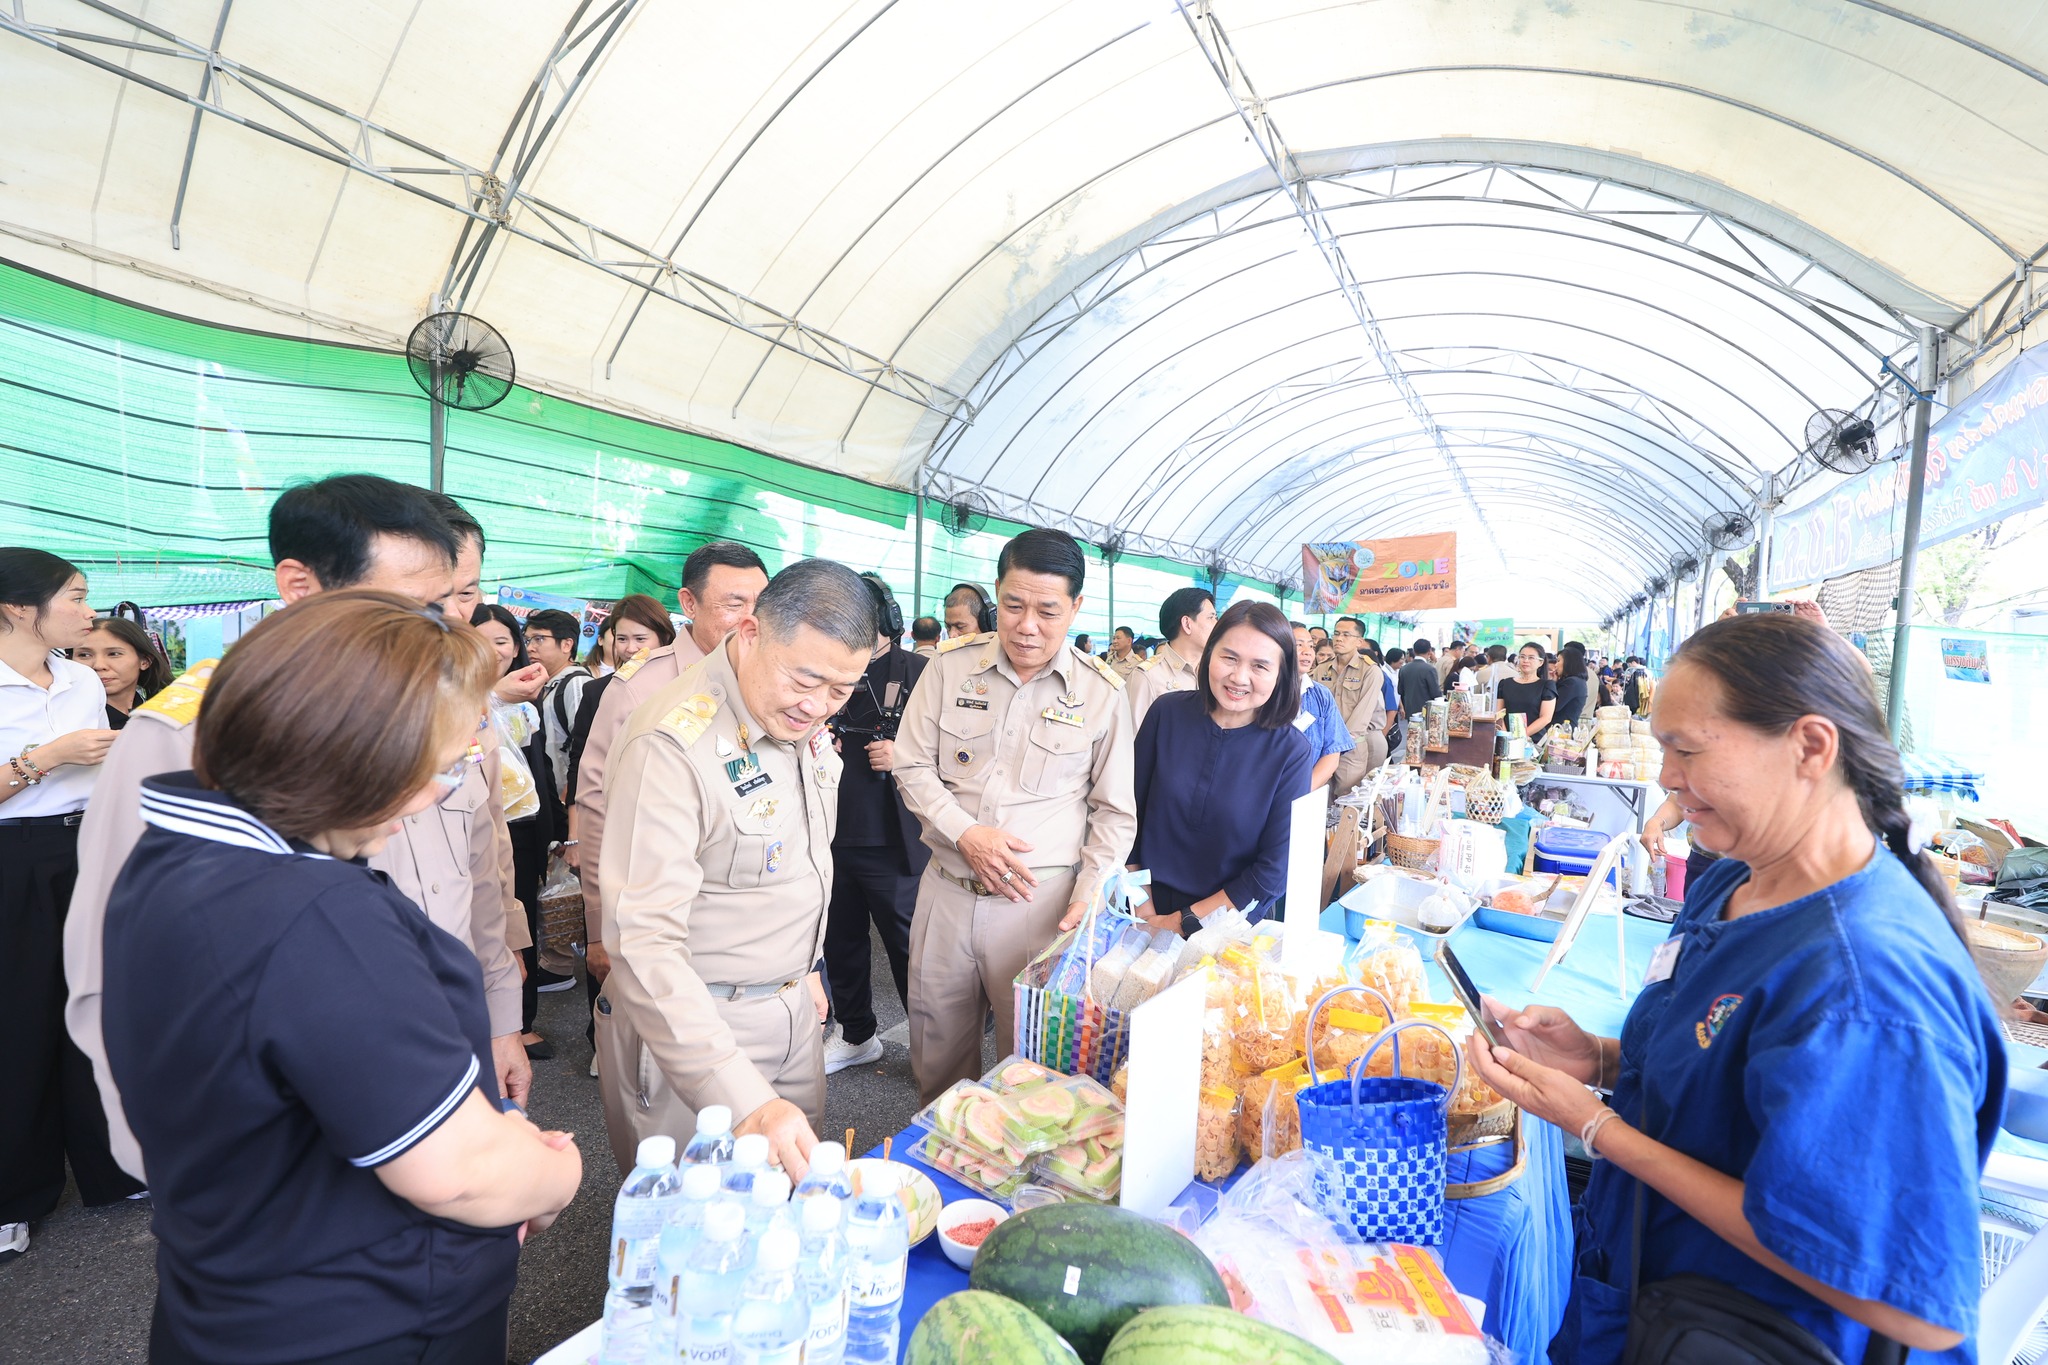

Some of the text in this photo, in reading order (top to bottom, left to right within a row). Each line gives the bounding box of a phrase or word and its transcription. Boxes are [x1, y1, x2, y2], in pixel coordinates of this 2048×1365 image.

[1382, 557, 1450, 579] ZONE
[1359, 579, 1450, 595] ภาคตะวันออกเฉียงเหนือ
[1378, 1311, 1392, 1329] PE
